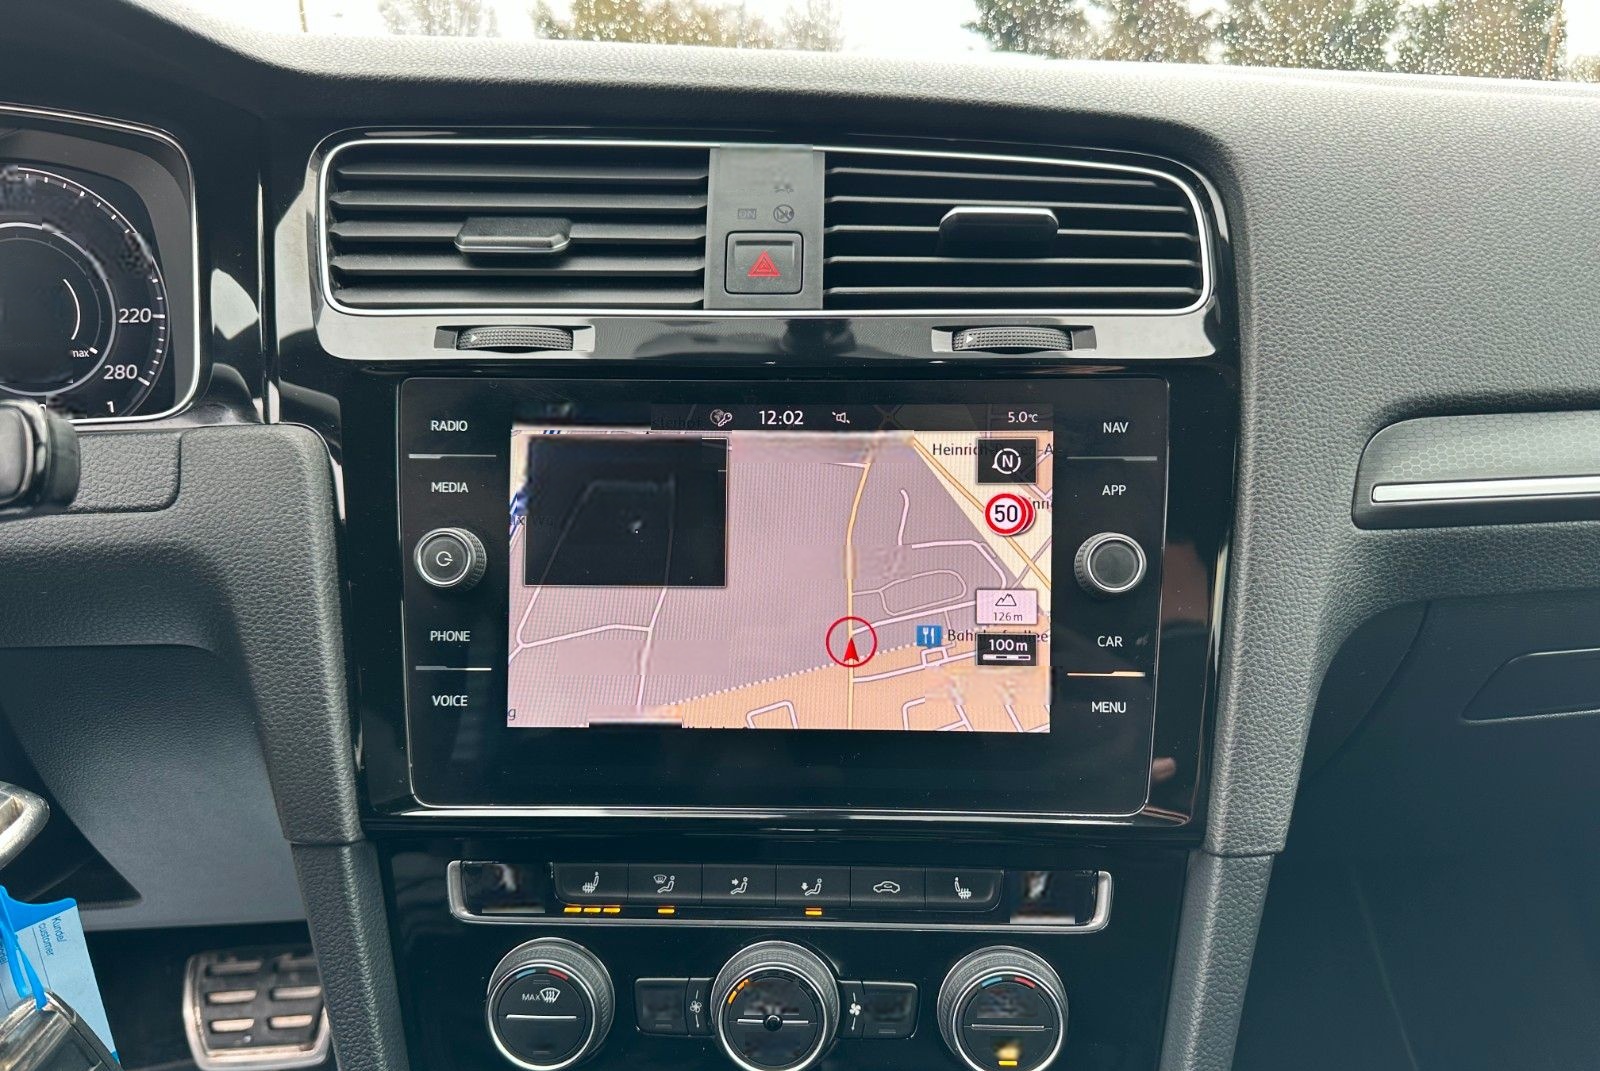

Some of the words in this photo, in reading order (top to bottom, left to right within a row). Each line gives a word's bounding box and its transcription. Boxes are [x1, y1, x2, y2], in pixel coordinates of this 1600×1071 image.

[118, 308, 152, 324] 220
[103, 364, 138, 380] 280
[758, 410, 804, 425] 12:02
[430, 420, 468, 432] RADIO
[1102, 422, 1129, 434] NAV
[1002, 454, 1013, 468] N
[430, 482, 469, 494] MEDIA
[1102, 484, 1127, 496] APP
[994, 504, 1018, 522] 50
[430, 630, 471, 643] PHONE
[1097, 635, 1124, 648] CAR
[431, 695, 468, 708] VOICE
[1091, 702, 1128, 714] MENU
[38, 922, 54, 956] customer
[521, 993, 541, 1001] MAX
